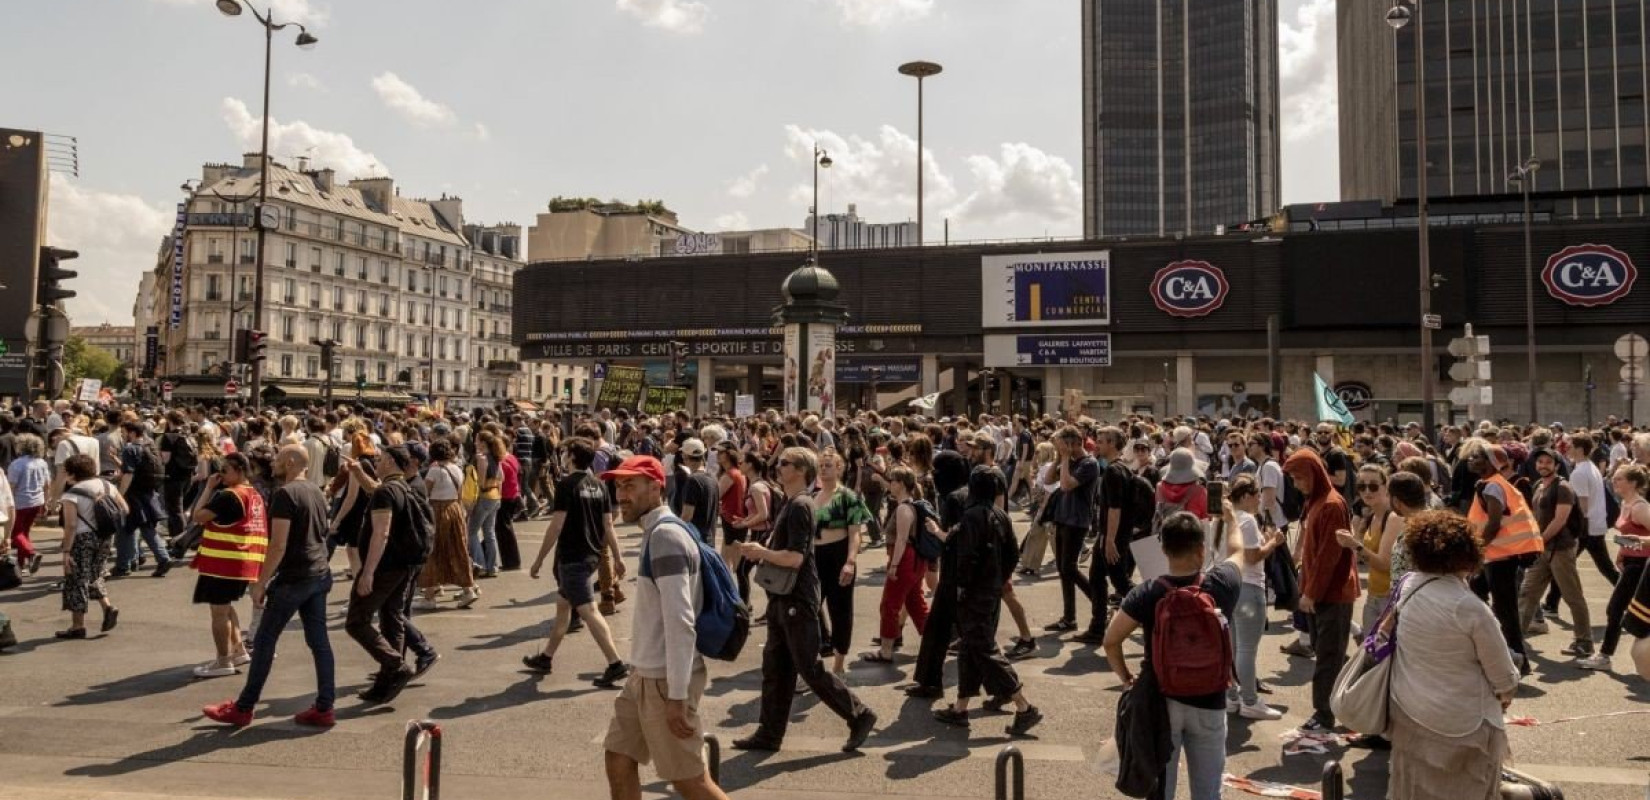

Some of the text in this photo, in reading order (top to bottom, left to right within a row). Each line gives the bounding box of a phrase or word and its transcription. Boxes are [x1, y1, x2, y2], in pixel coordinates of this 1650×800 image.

[1015, 261, 1107, 272] MONTPARNASSE
[1561, 261, 1620, 287] C&A
[1165, 276, 1214, 300] C&A
[1073, 295, 1107, 305] CENTRE
[1045, 306, 1107, 315] COMMERCIAL
[745, 328, 768, 336] PUBLIC
[841, 326, 864, 334] PUBLIC
[543, 345, 572, 357] VILLE
[577, 345, 593, 356] DE
[597, 344, 631, 355] PARIS
[641, 343, 690, 354] CENTE
[695, 341, 748, 353] SPORTIF
[753, 341, 767, 353] ET
